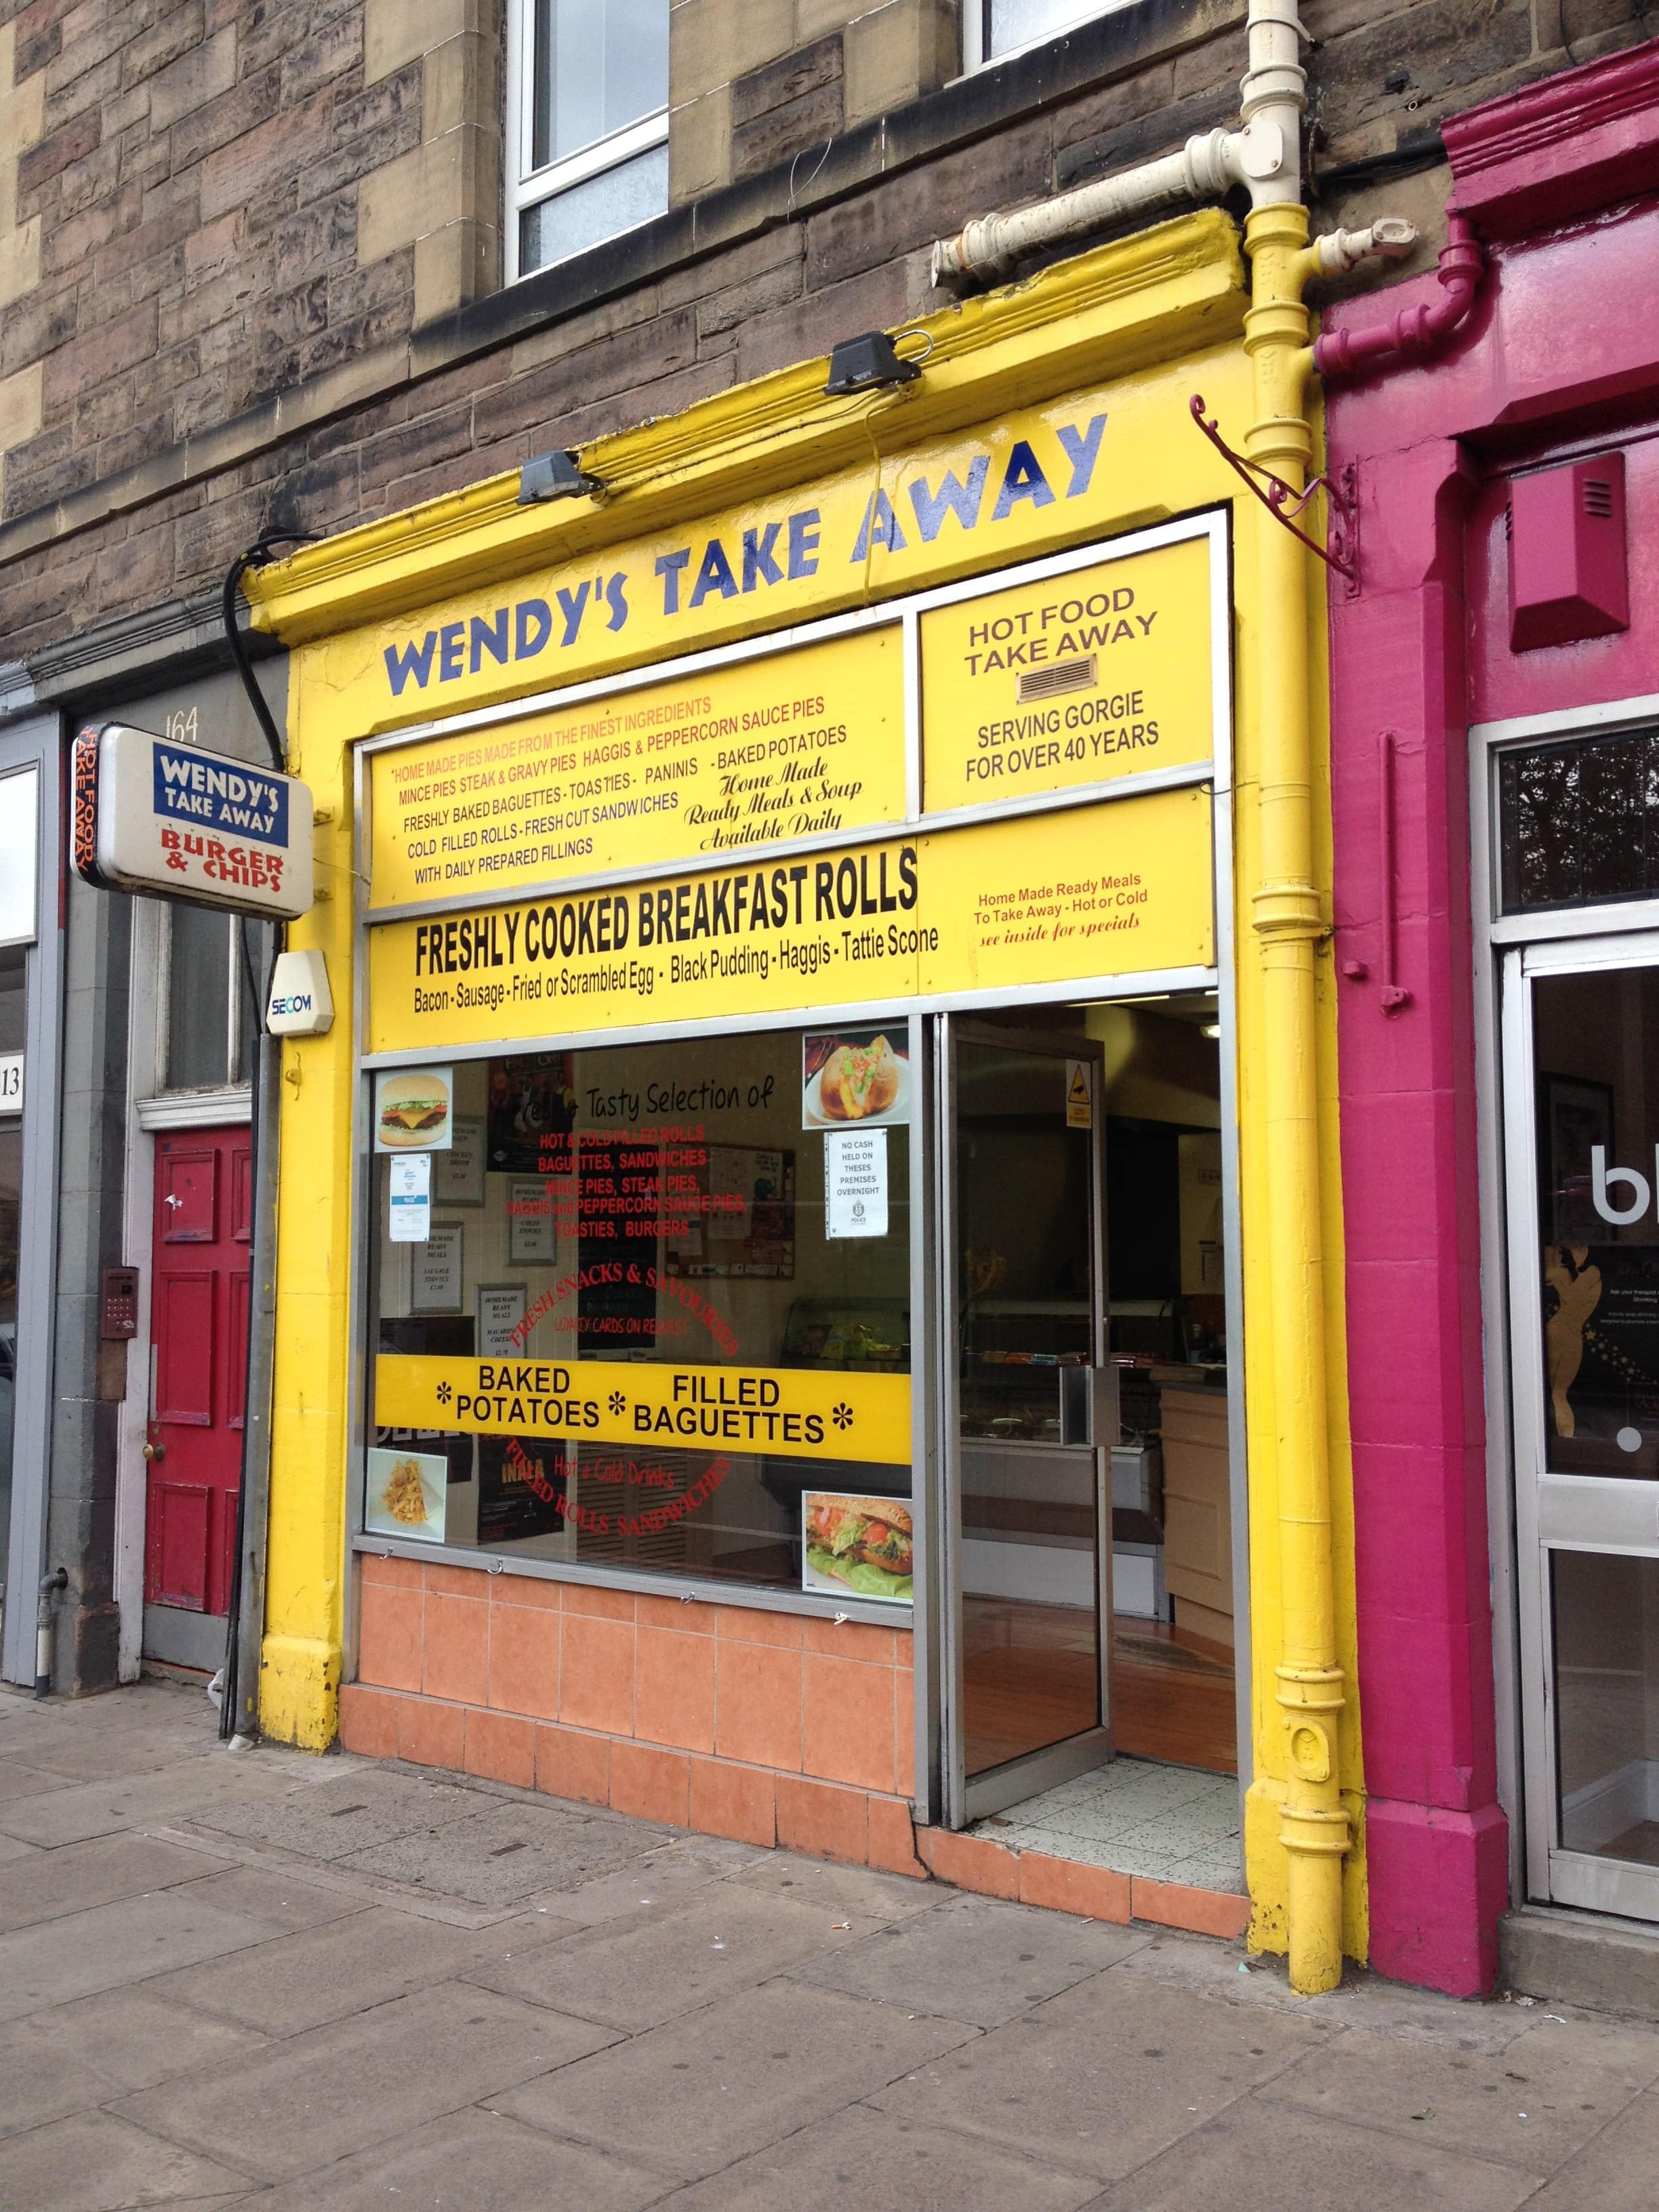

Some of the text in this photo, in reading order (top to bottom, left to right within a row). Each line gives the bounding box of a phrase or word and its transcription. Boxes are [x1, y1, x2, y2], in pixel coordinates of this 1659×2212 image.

[384, 413, 1108, 697] WENDY'S TAKE AWAY
[970, 587, 1134, 647] HOT FOOD
[964, 611, 1158, 676] TAKE AWAY
[166, 706, 198, 741] 164
[395, 696, 711, 783] HOME MADE PIES MADE FROM THE FINEST INGREDIENTS
[978, 690, 1144, 748] SERVING GORGIE
[399, 696, 825, 806] MINCE PIES STEAK & GRAVY PIES HAGGIS & PEPPERCORN SAUCE PIES
[966, 720, 1160, 781] FOR OVER 40 YEARS
[84, 733, 98, 861] HOT FOOD
[160, 756, 278, 813] WENDY'S
[404, 724, 847, 833] FRESHLY BAKED BAGUETTES TOASTIES PANINIS BAKED POTATOES
[719, 756, 828, 797] Home Made
[75, 727, 92, 872] TAKE AWAY
[165, 787, 274, 834] TAKE AWAY
[683, 779, 862, 826] Ready Meals & Soup
[407, 792, 678, 859] COLD FILLED ROLLS FRESH CUT SANDWICHES
[700, 807, 842, 851] Available Daily
[161, 829, 284, 874] BURGER
[166, 852, 281, 893] & CHIPS
[415, 838, 592, 884] WITH DAILY PREPARED FILLINGS
[416, 847, 918, 976] FRESHLY COOKED BREAKFAST ROLLS
[974, 889, 1147, 924] To Take Away Hot or Cold
[979, 873, 1141, 906] Home Made Ready Meals
[979, 912, 1140, 947] see inside for specials
[415, 924, 939, 1013] Bacon Sausage Fried or Scrambled Egg Black Pudding Haggis Tattie Scone
[272, 994, 311, 1015] SECOM
[587, 1075, 774, 1122] Tasty Selection of
[540, 1124, 705, 1149] HOT & COLD FILLED ROLLS
[538, 1149, 706, 1172] BAGUETTES, SANDWICHES
[840, 1176, 876, 1184] PREMISES
[845, 1164, 871, 1172] THESES
[506, 1193, 747, 1215] HAGGIS and PEPPERCORN SAUCE PIES,
[546, 1179, 583, 1195] MINCE
[586, 1177, 617, 1196] PIES,
[622, 1176, 663, 1193] STEAK
[667, 1174, 699, 1194] PIES,
[837, 1187, 880, 1195] OVERNIGHT
[555, 1221, 689, 1239] TOASTIES, BURGERS
[510, 1262, 740, 1357] FRESH SNACKS & SAVOURIES
[553, 1317, 688, 1335] LOYALTY CARDS ON REQUEST
[479, 1366, 570, 1393] BAKED
[674, 1374, 779, 1407] FILLED
[457, 1395, 599, 1428] POTATOES
[634, 1404, 824, 1443] BAGUETTES
[506, 1437, 730, 1536] FILLED ROLLS SANDWICHES
[554, 1455, 675, 1488] Hot Cold Drinks
